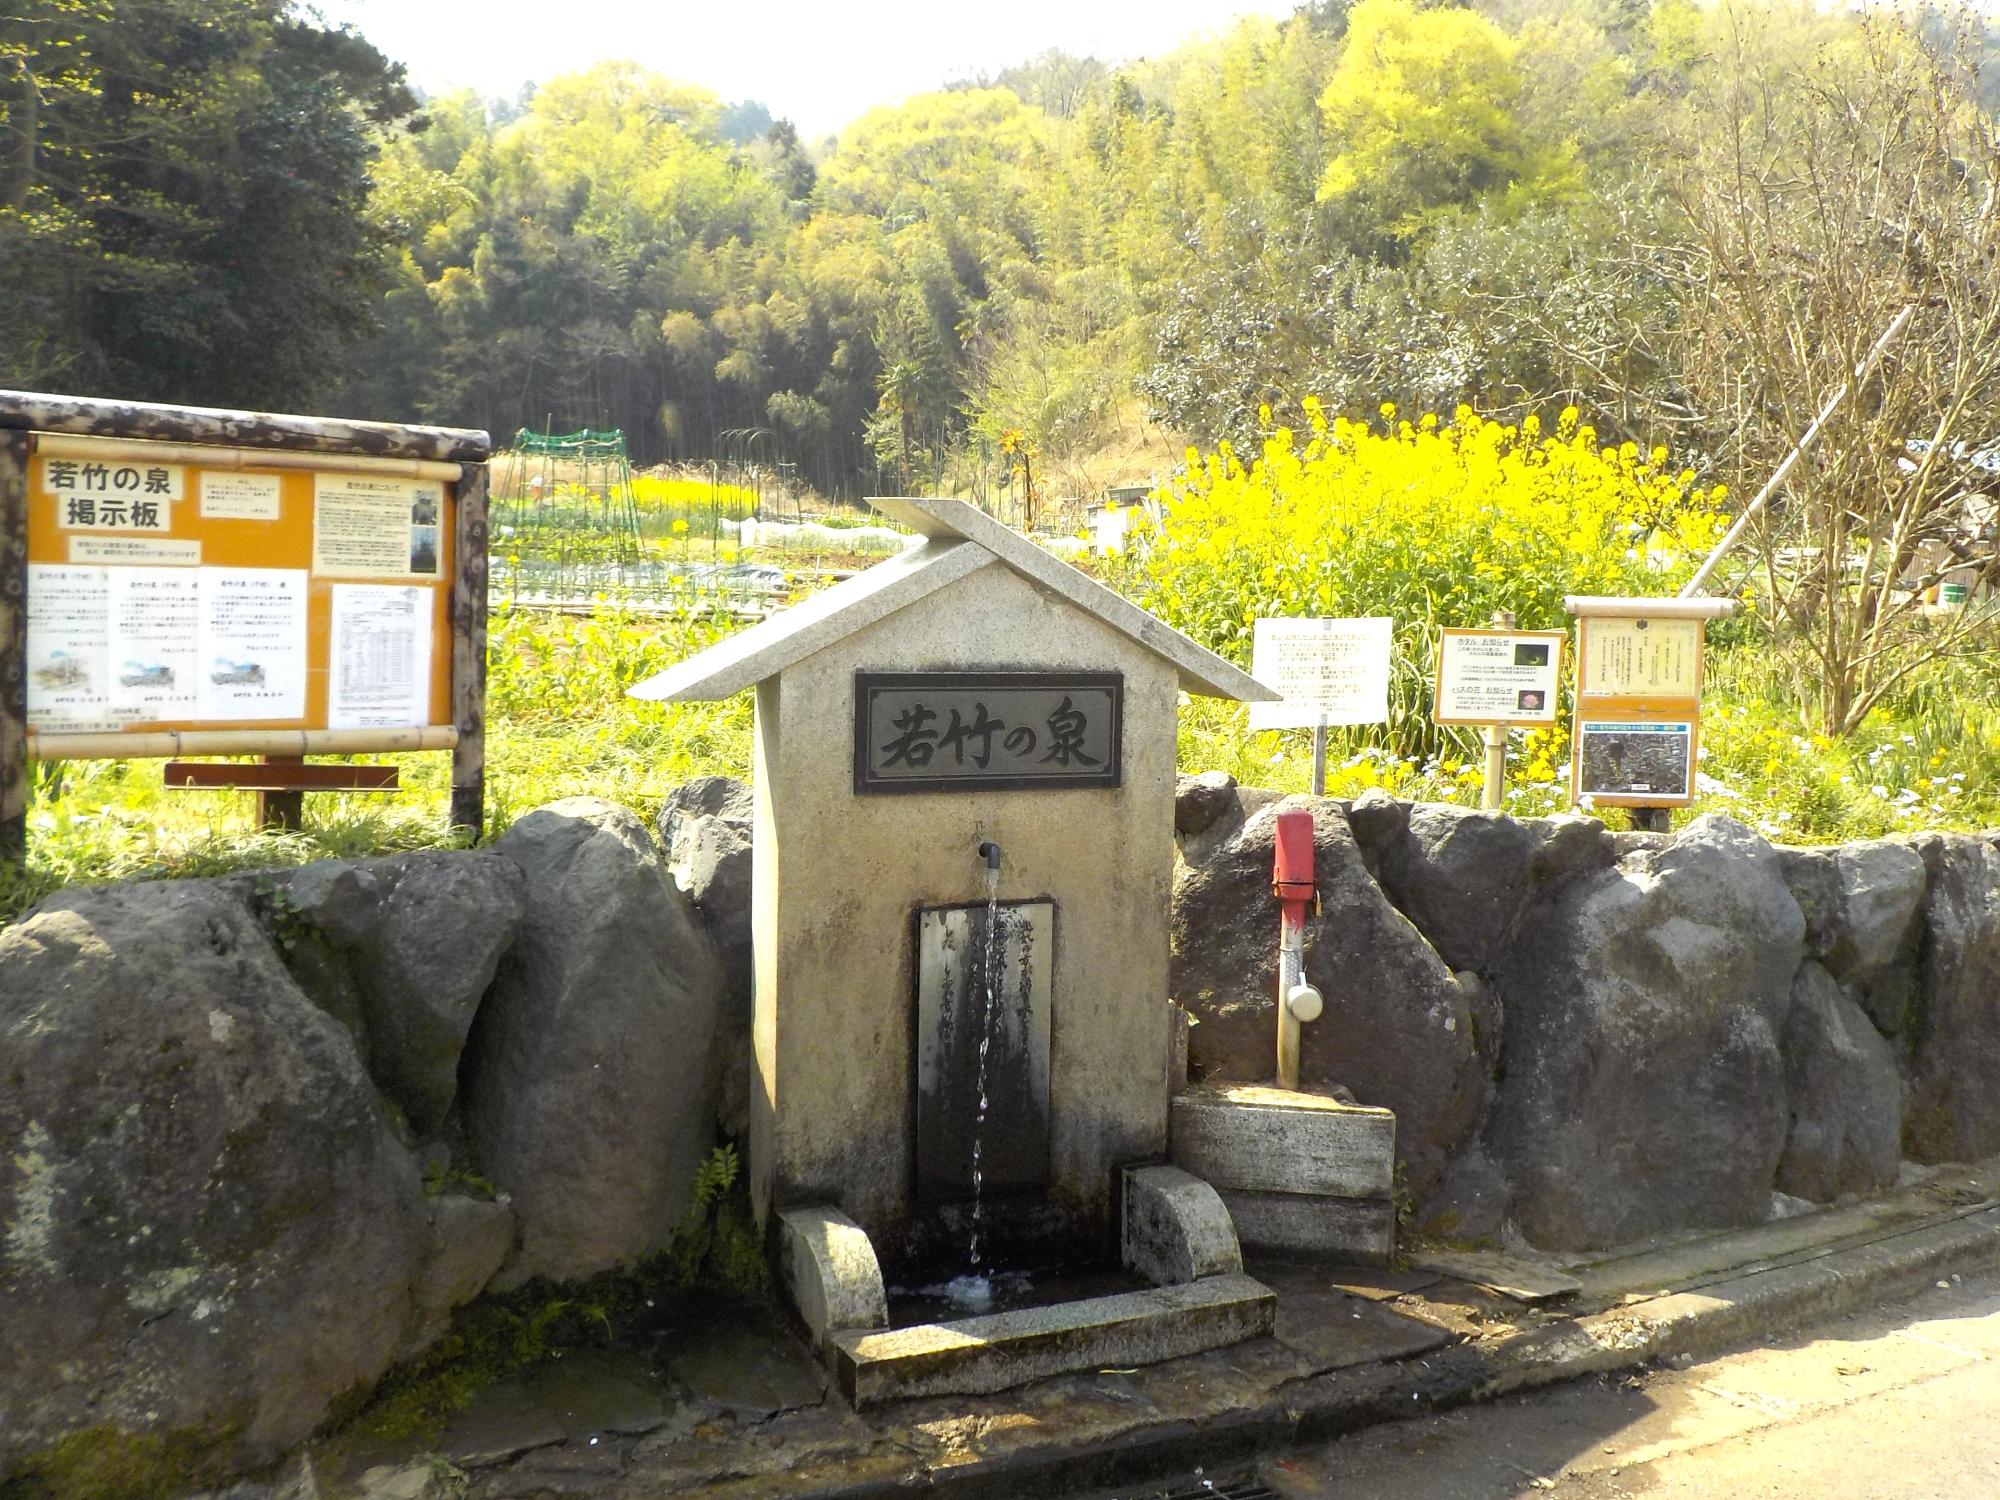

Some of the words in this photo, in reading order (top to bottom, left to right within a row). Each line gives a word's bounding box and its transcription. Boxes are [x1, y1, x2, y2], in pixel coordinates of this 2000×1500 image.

[49, 461, 171, 494] 若竹の泉
[68, 498, 160, 528] 掲示板
[1457, 638, 1477, 646] ホタル
[1482, 639, 1510, 647] お知らせ
[880, 696, 1101, 769] 若竹の泉
